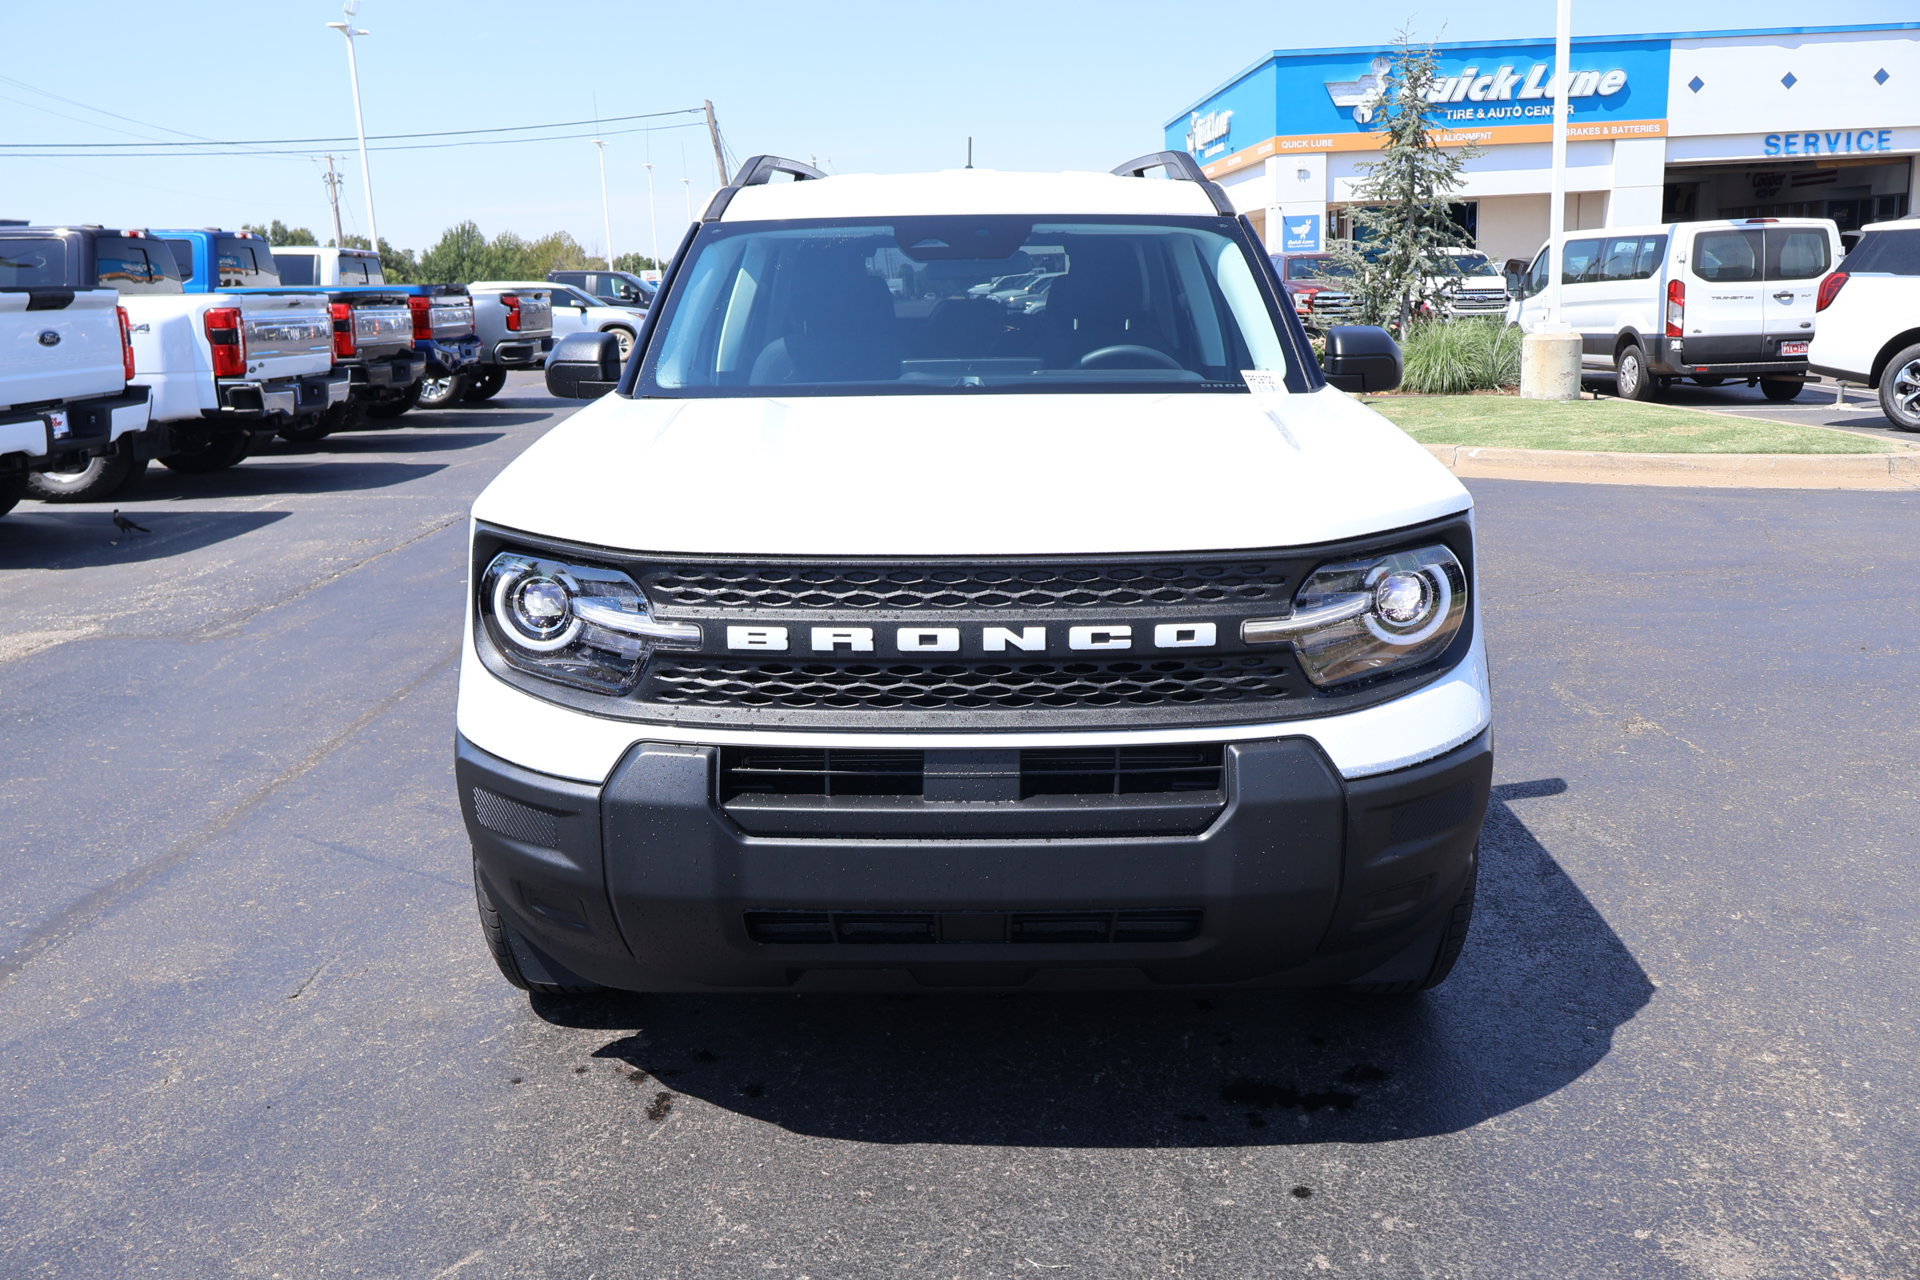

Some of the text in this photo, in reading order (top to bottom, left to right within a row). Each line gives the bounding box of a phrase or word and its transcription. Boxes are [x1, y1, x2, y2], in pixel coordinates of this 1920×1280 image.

[1517, 63, 1628, 100] Lane
[1446, 104, 1575, 121] TIRE & AUTO CENTR
[1442, 131, 1493, 142] ALIGNMENT
[1566, 124, 1661, 137] BRAKES & BATTERIES
[1281, 139, 1308, 149] QUICK
[1310, 138, 1333, 148] LUBE
[1764, 130, 1893, 155] SERVICE
[726, 622, 1217, 652] BRONCO
